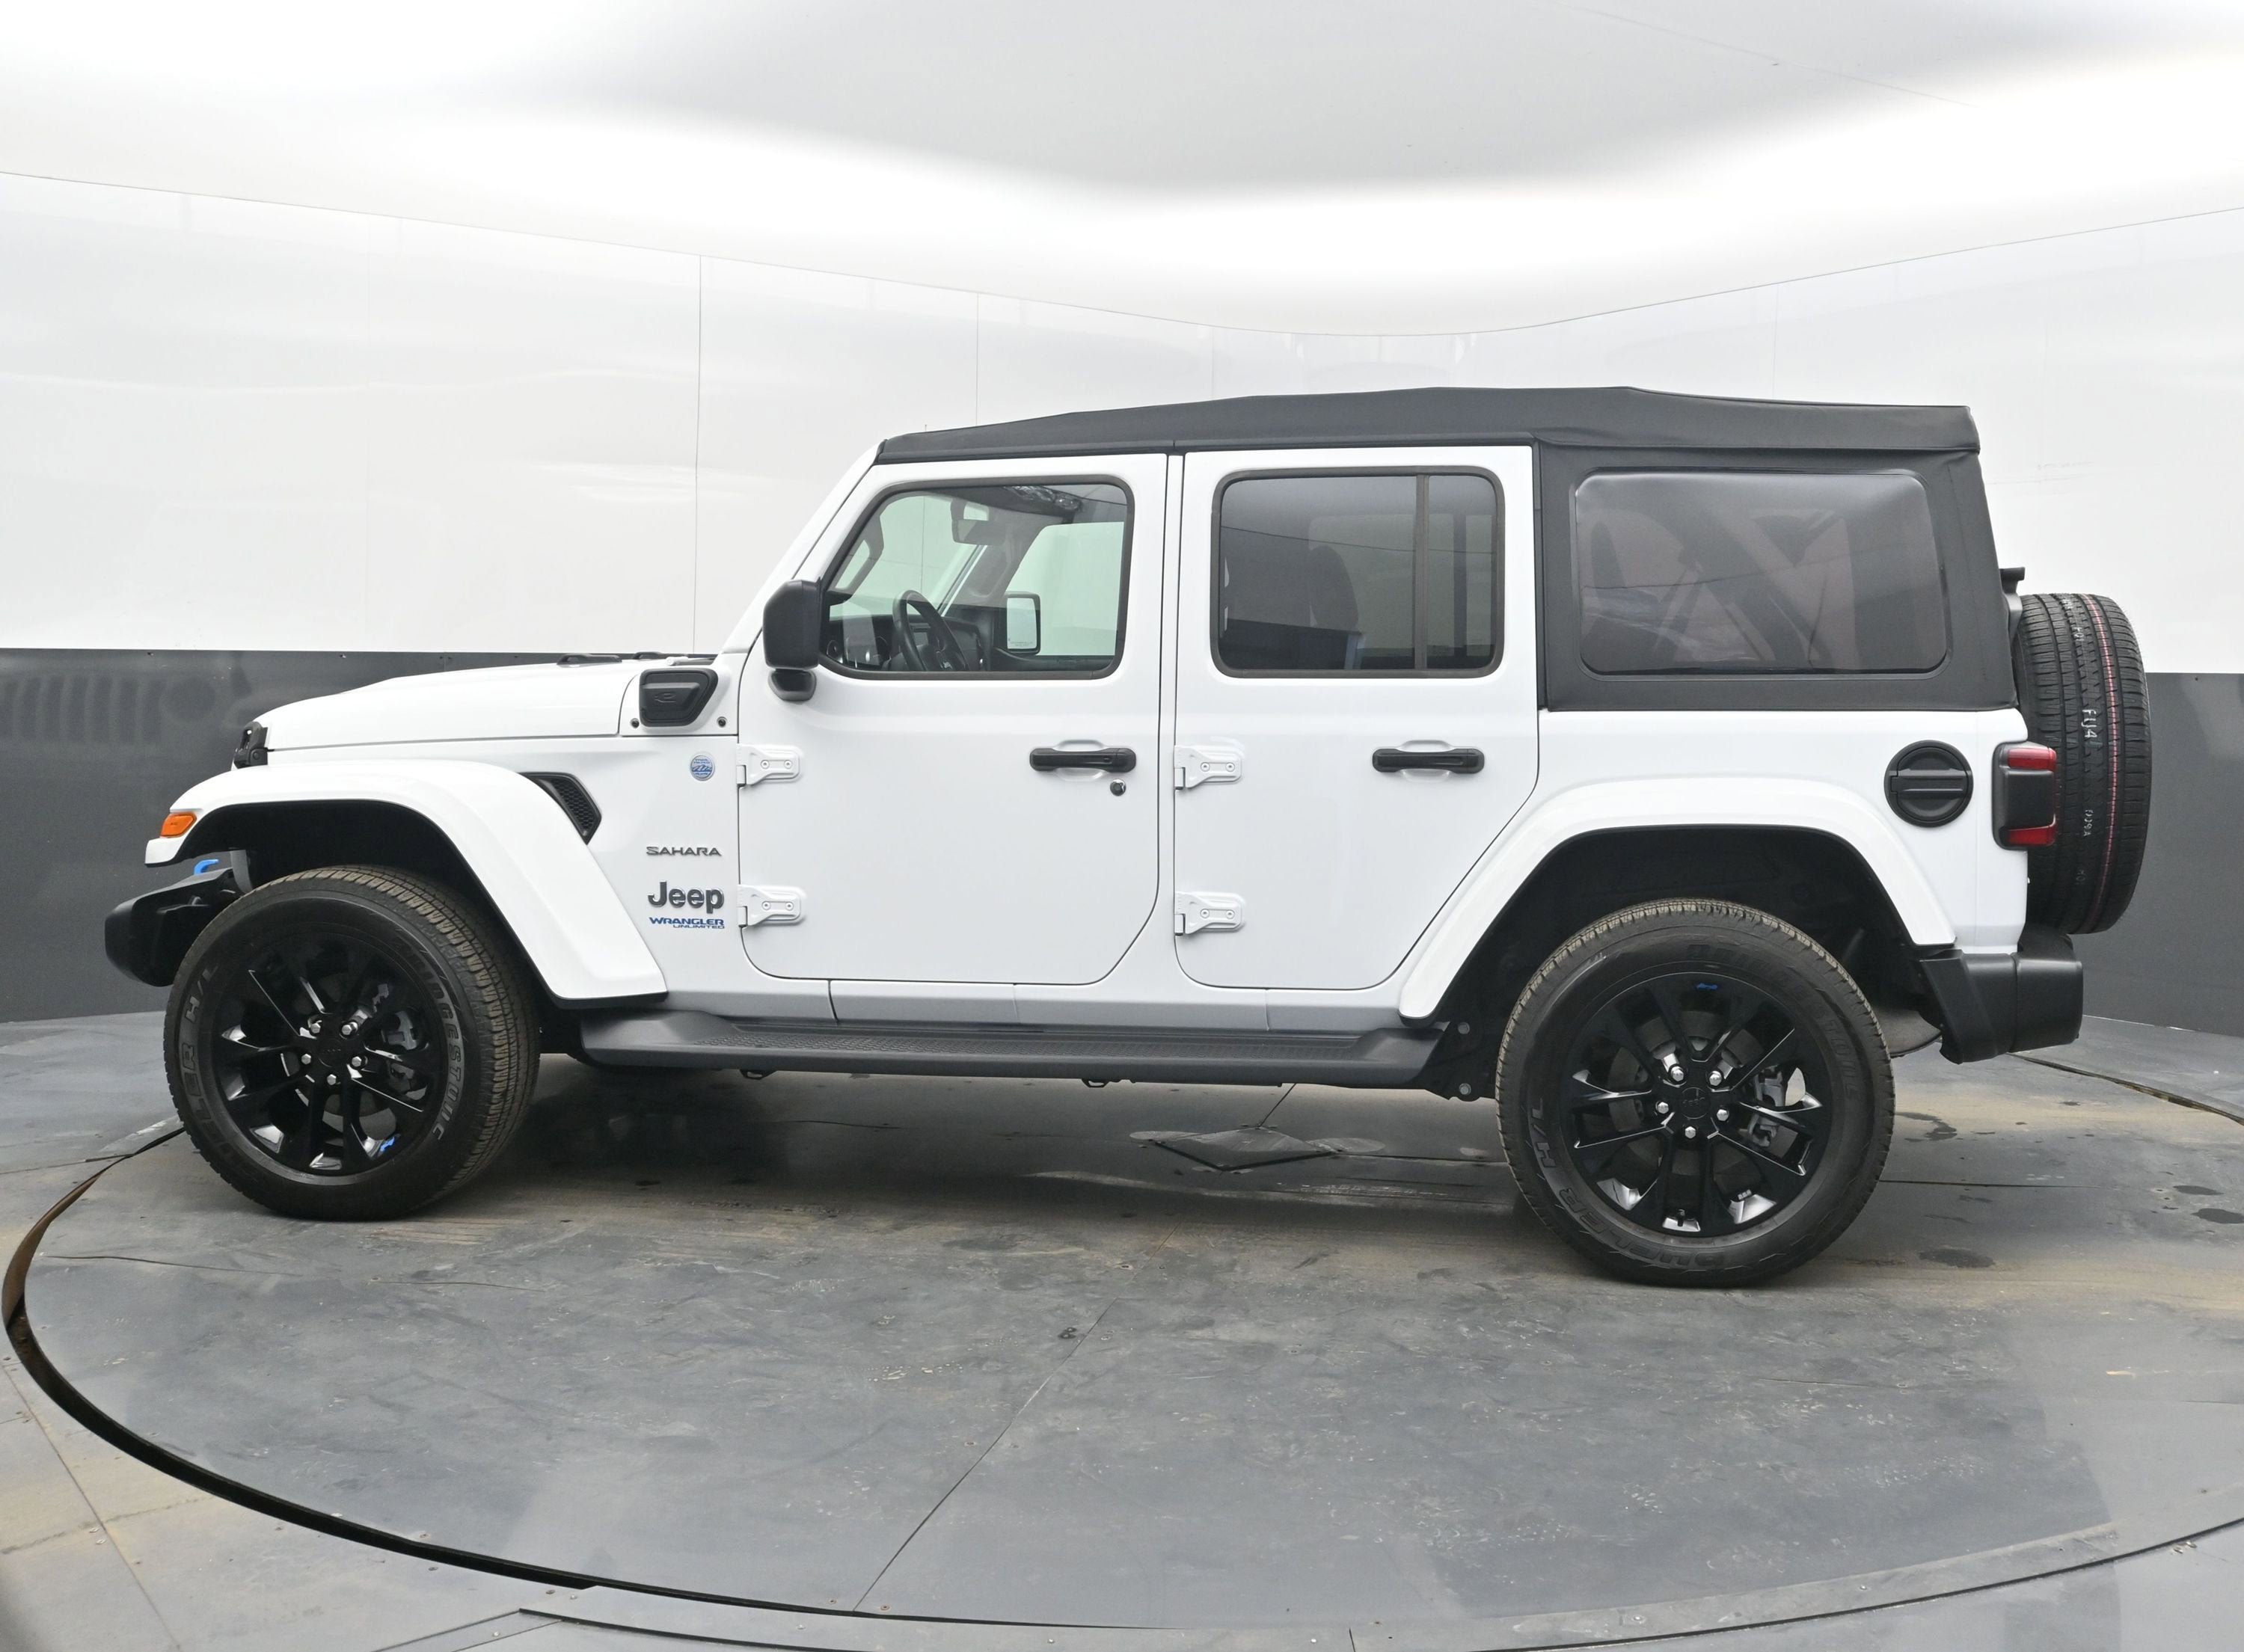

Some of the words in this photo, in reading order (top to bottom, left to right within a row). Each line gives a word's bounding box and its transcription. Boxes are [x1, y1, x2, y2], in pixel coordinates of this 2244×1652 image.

[646, 846, 723, 856] SAHARA
[647, 880, 725, 915] Jeep
[649, 917, 725, 926] WRANGLER
[1530, 1097, 1557, 1169] H/L
